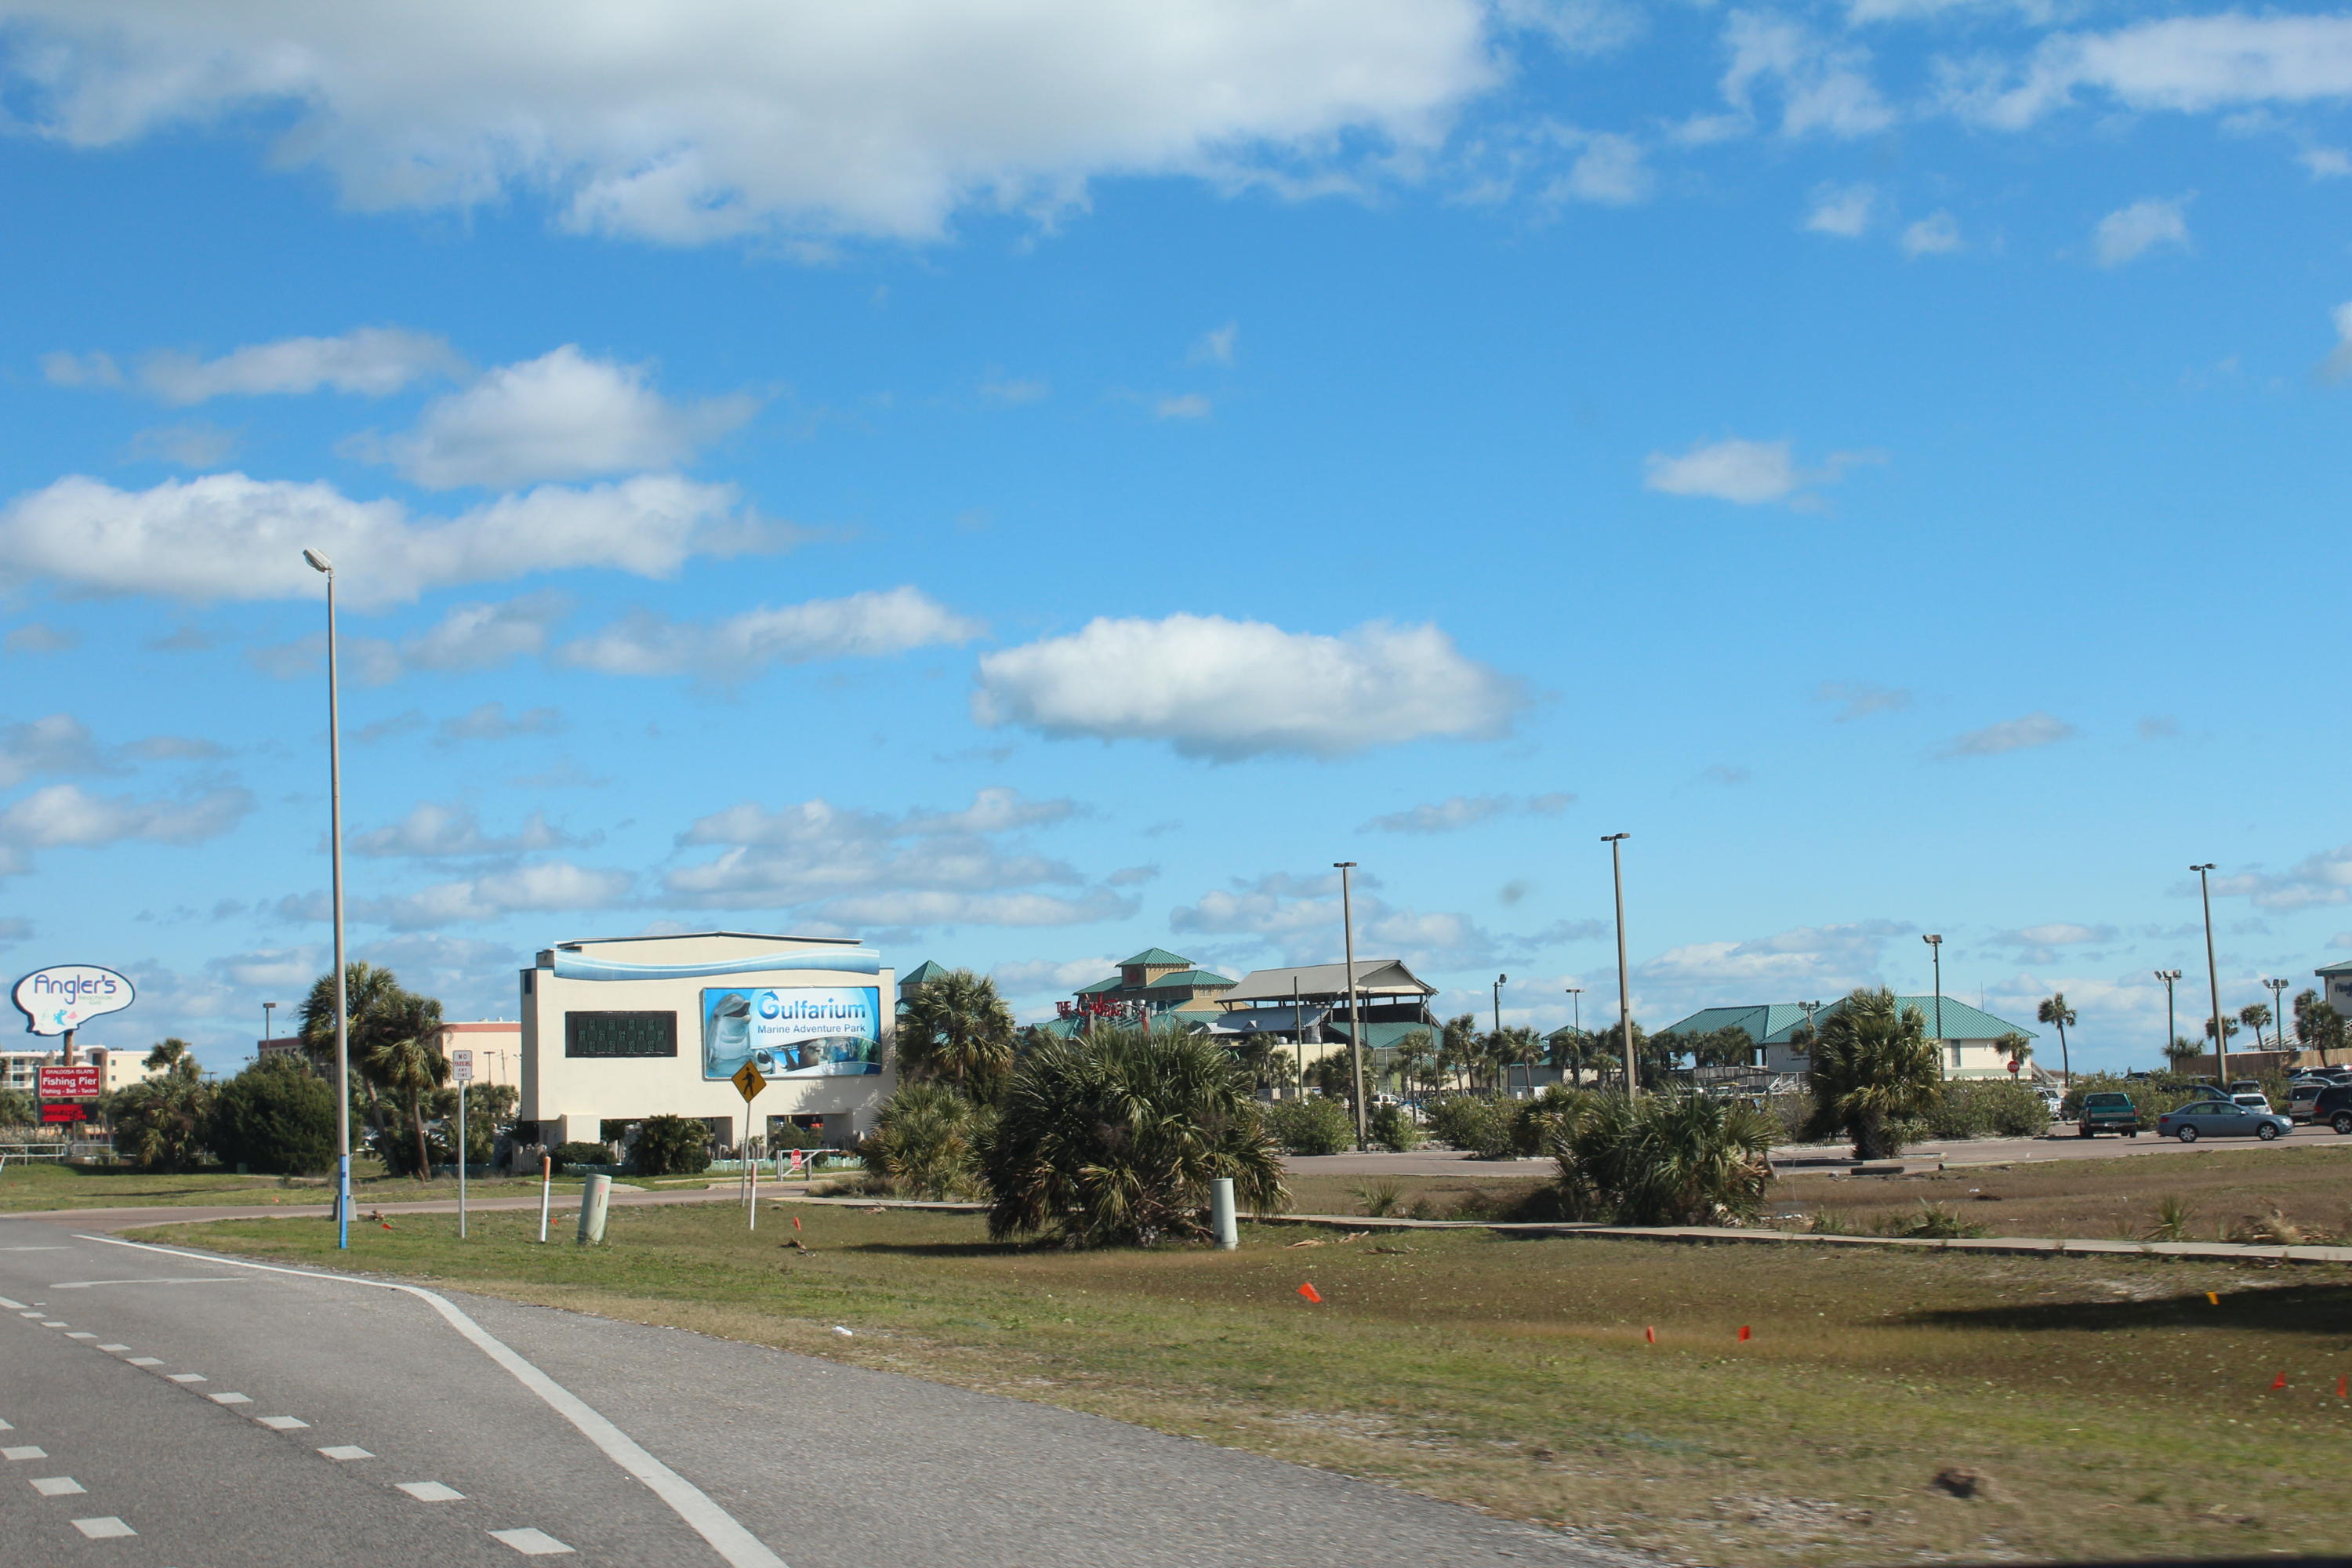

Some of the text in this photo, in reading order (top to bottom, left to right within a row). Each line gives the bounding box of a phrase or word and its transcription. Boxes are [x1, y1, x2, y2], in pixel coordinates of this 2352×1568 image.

[34, 975, 117, 1004] Angler's
[757, 990, 866, 1019] Gulfarium
[757, 1024, 866, 1033] Marine Adventure Park
[42, 1076, 97, 1087] Fishing Pier
